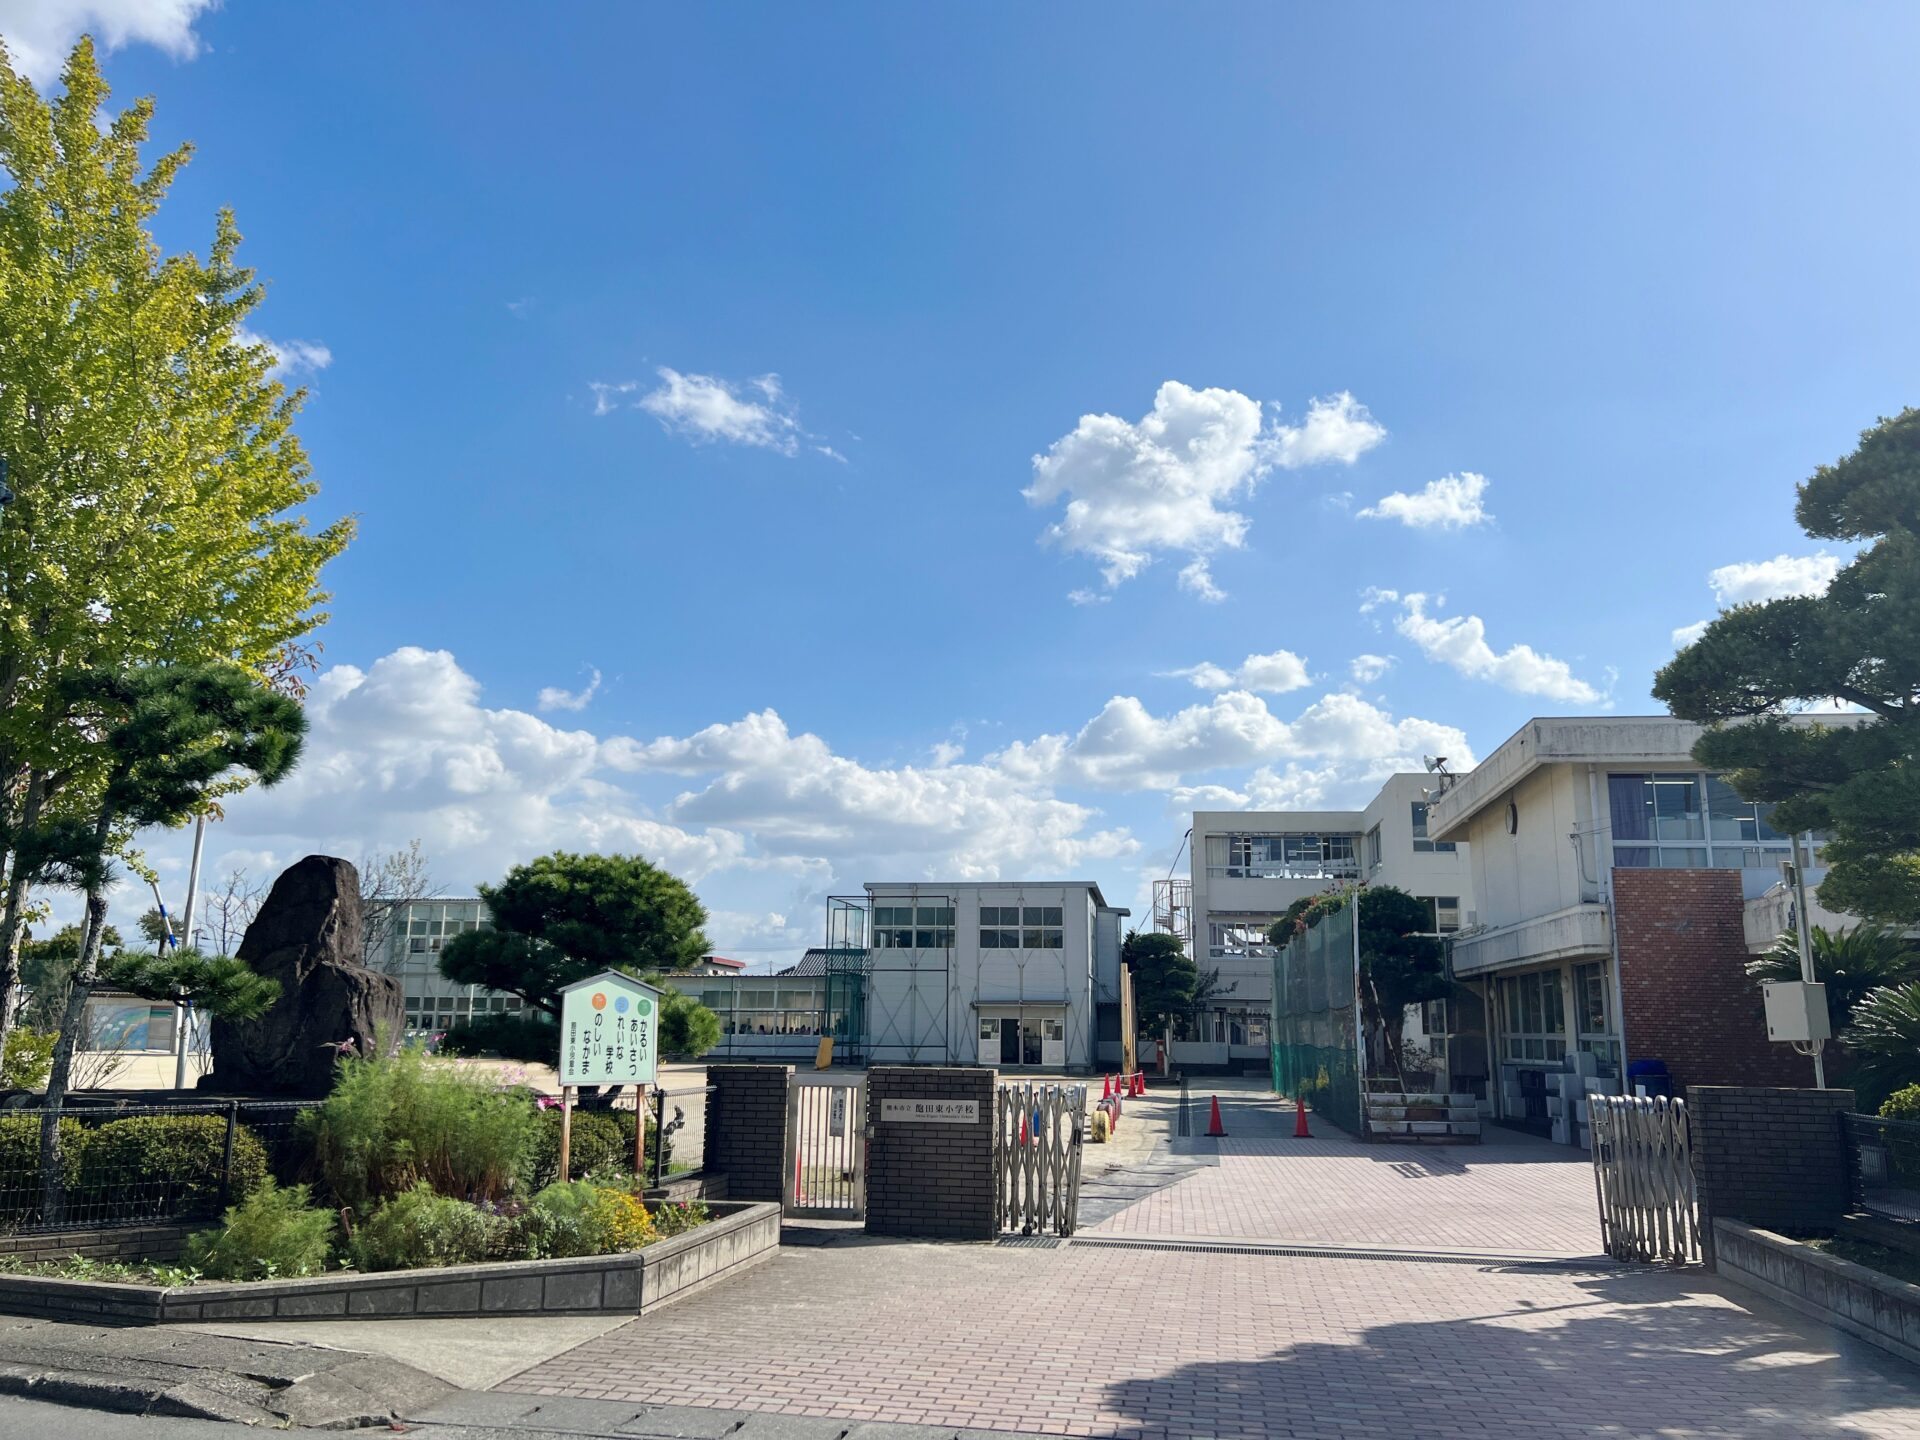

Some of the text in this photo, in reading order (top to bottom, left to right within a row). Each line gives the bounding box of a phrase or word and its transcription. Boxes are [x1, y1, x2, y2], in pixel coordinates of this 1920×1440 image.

[582, 1029, 591, 1075] なかま
[605, 1045, 614, 1074] 学校
[629, 1018, 638, 1076] あいさつ
